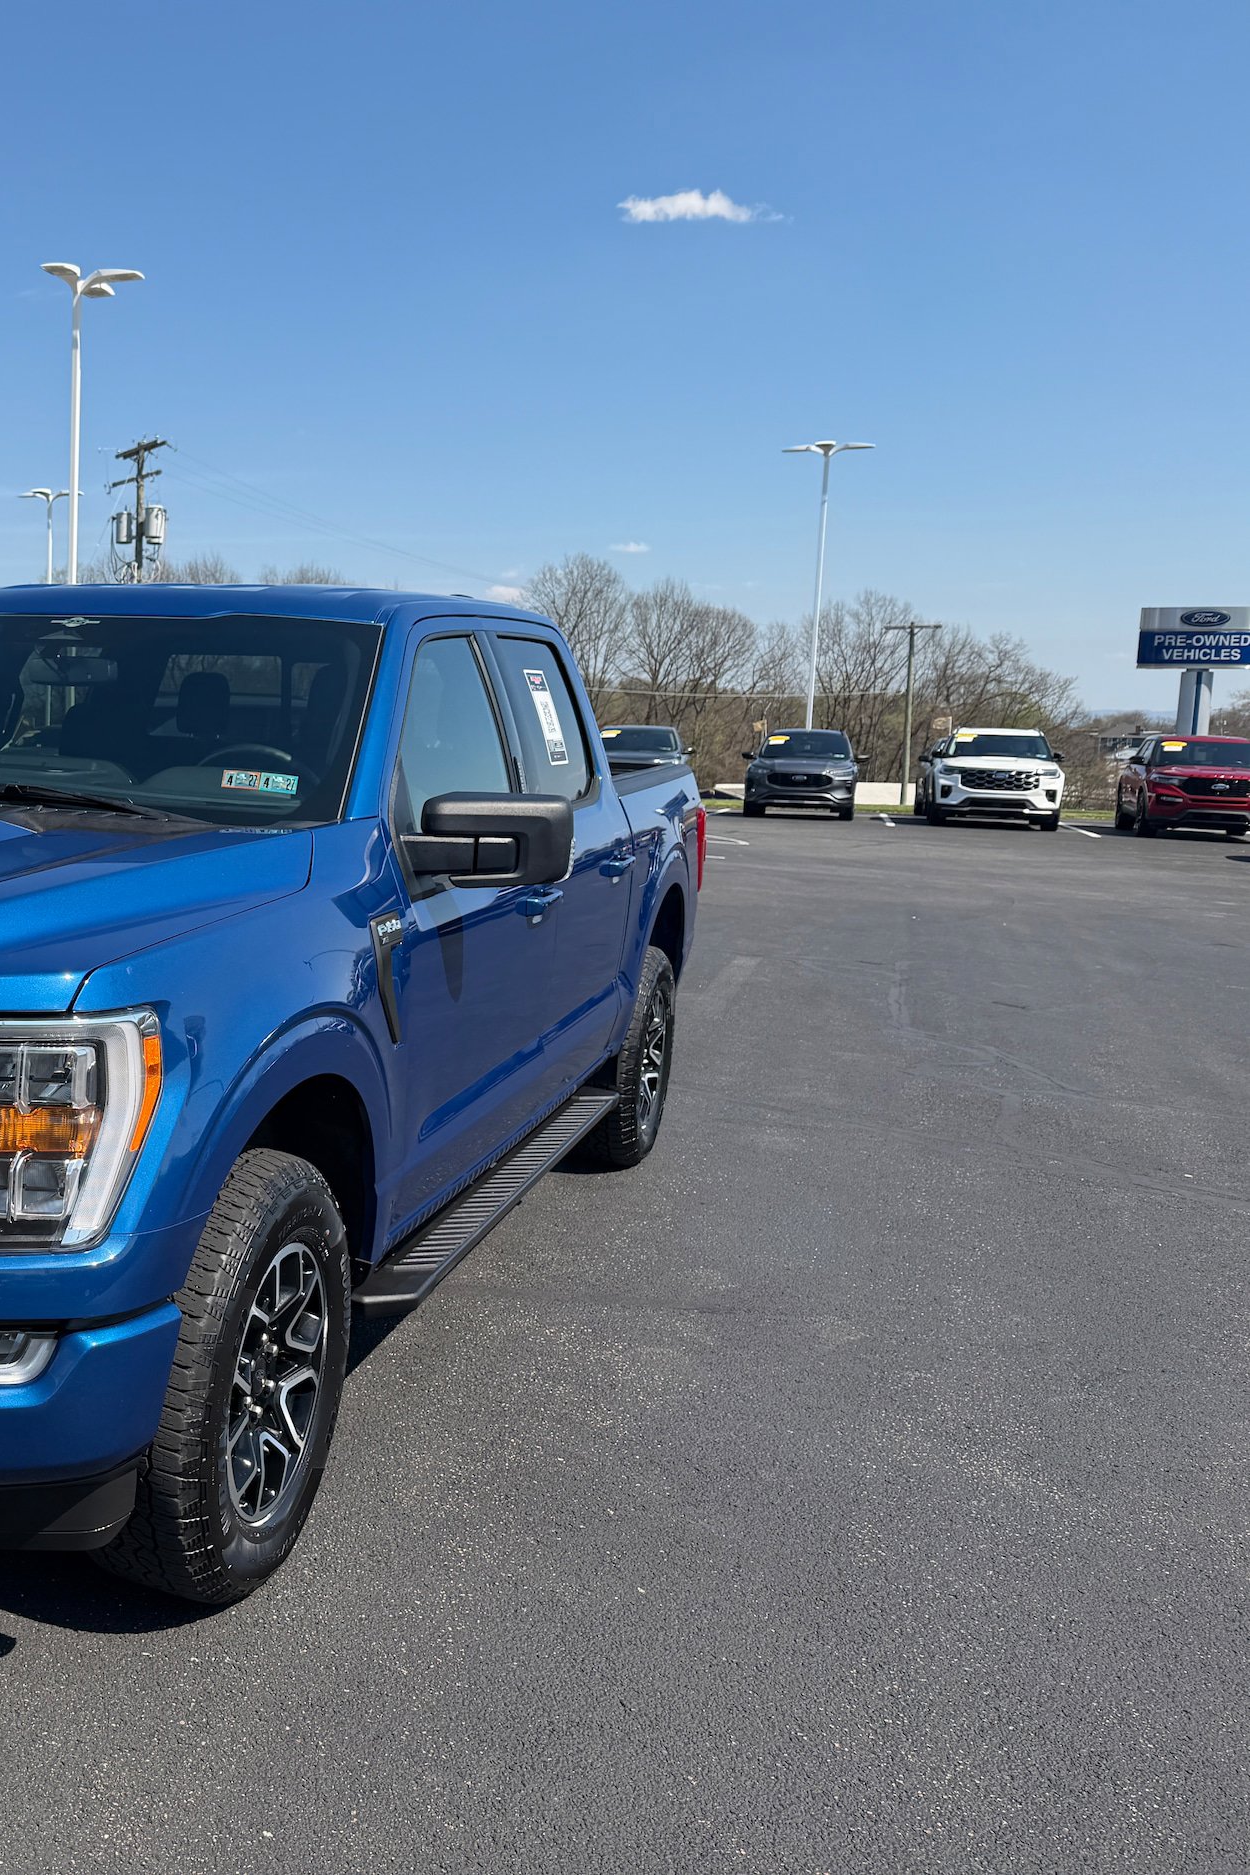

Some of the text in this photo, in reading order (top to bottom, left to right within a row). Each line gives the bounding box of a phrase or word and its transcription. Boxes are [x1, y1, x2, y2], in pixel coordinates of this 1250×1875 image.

[1191, 612, 1221, 624] Ford
[1153, 634, 1250, 647] PRE-OWNED
[1162, 648, 1242, 661] VEHICLES
[227, 774, 258, 787] 4 27
[263, 777, 270, 788] 4
